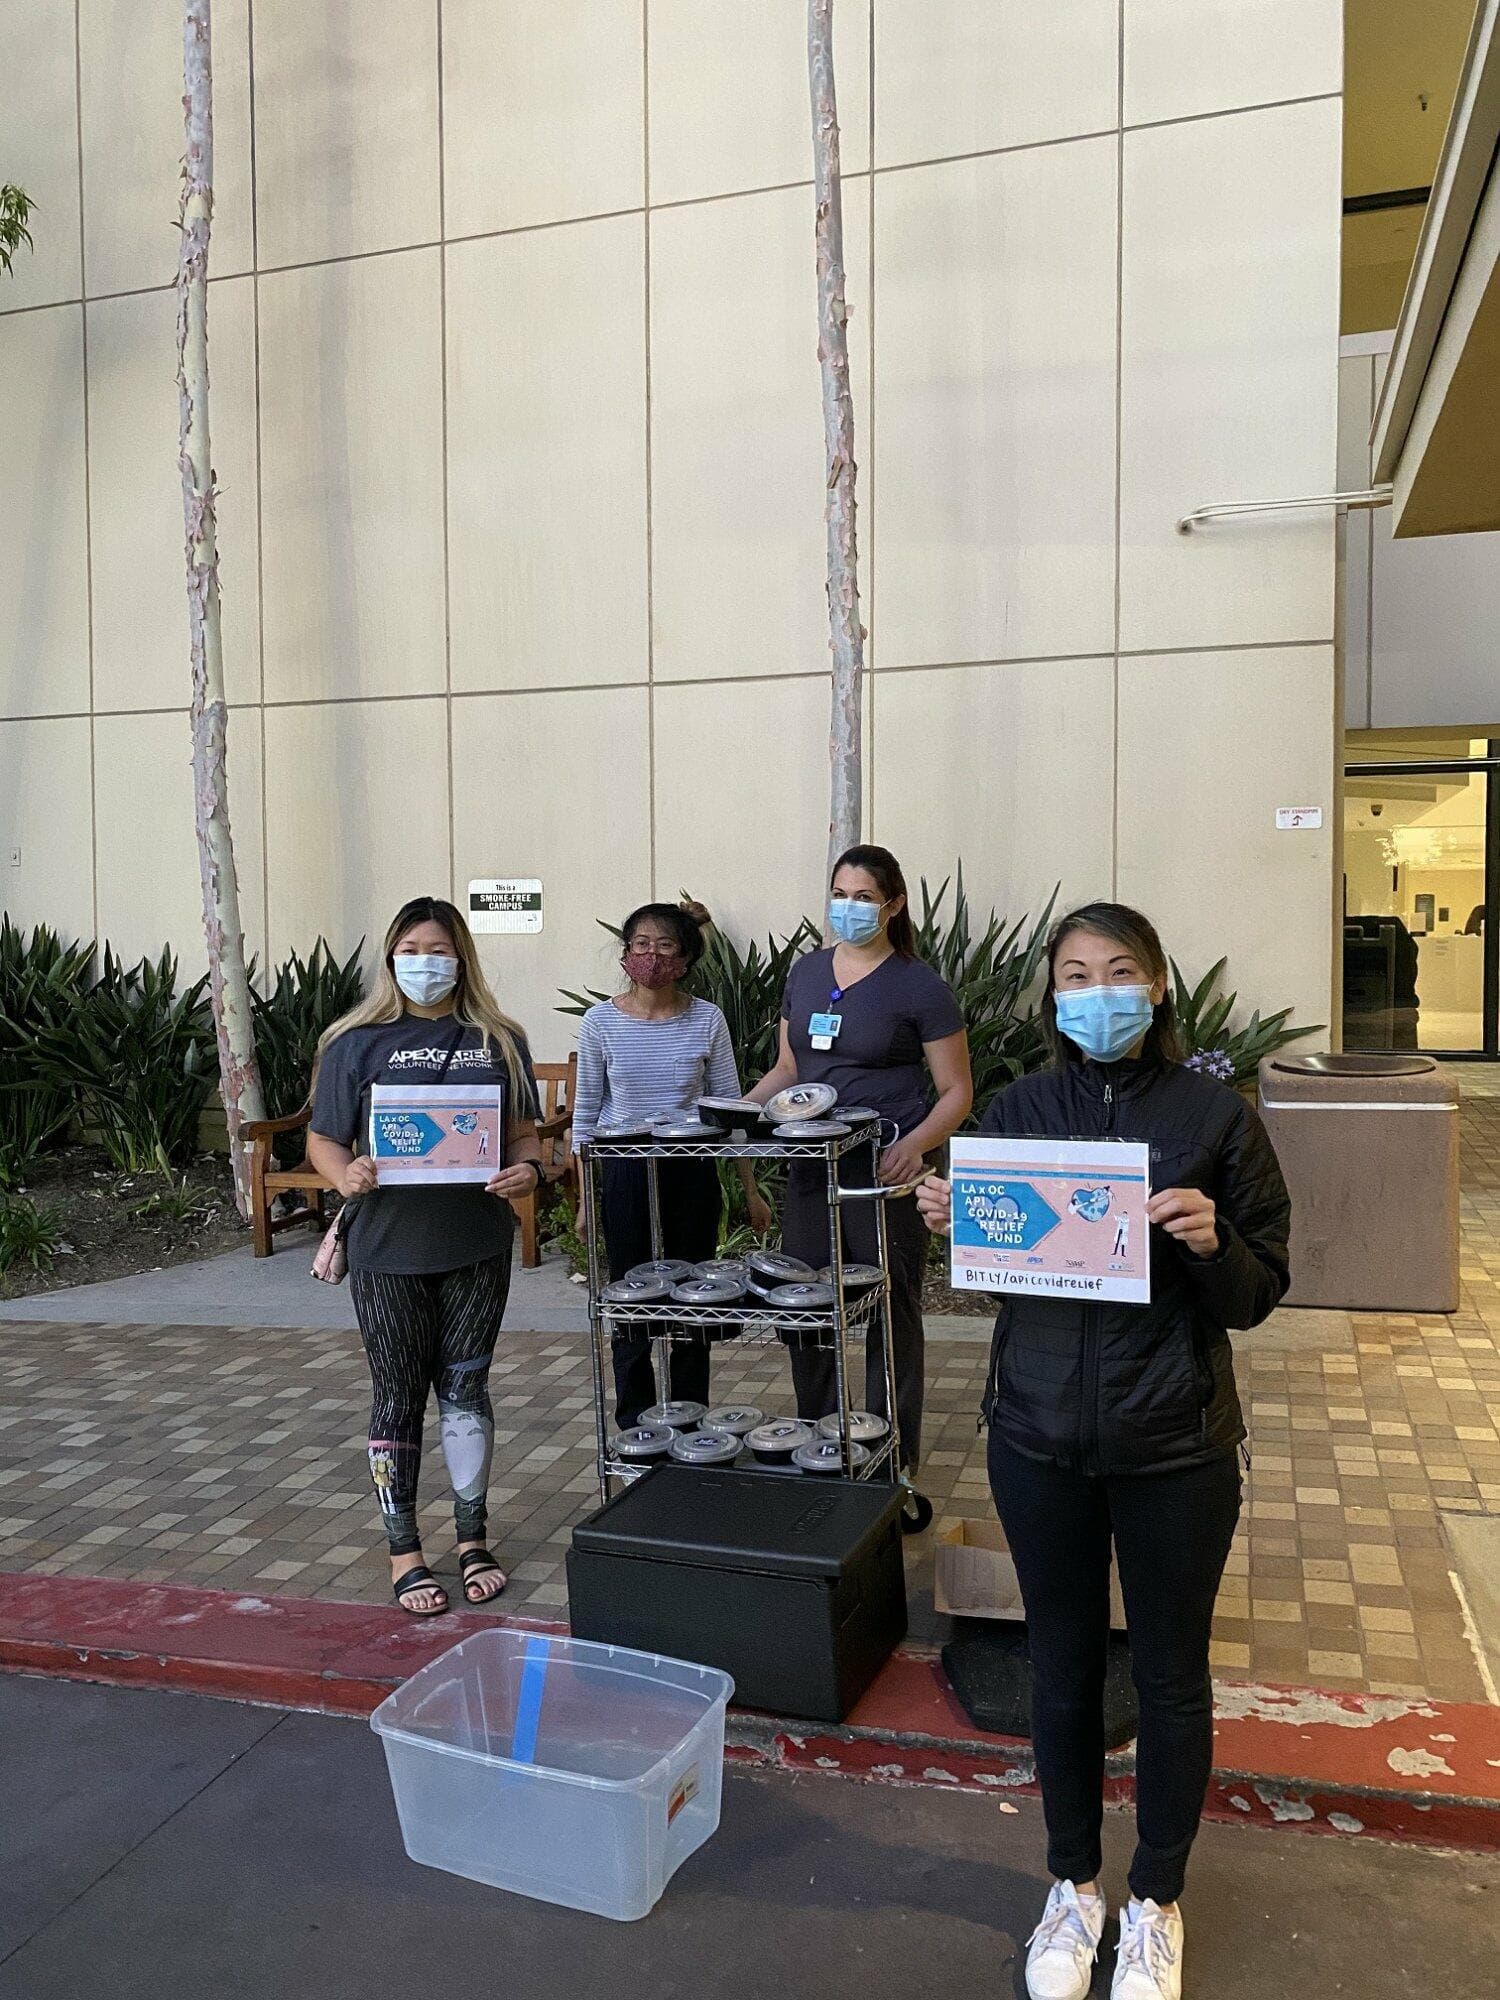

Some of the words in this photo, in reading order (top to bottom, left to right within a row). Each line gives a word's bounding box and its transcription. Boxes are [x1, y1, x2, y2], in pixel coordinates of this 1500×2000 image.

[480, 894, 532, 903] SMOKE-FREE
[488, 902, 523, 911] CAMPUS
[379, 1115, 391, 1123] LA
[398, 1115, 410, 1123] OC
[383, 1131, 425, 1139] COVID-19
[961, 1183, 977, 1194] LA
[979, 1186, 986, 1195] x
[987, 1185, 1006, 1195] OC
[964, 1196, 986, 1206] API
[967, 1208, 1028, 1222] COVID-19
[979, 1220, 1025, 1232] RELIEF
[987, 1232, 1023, 1244] FUND
